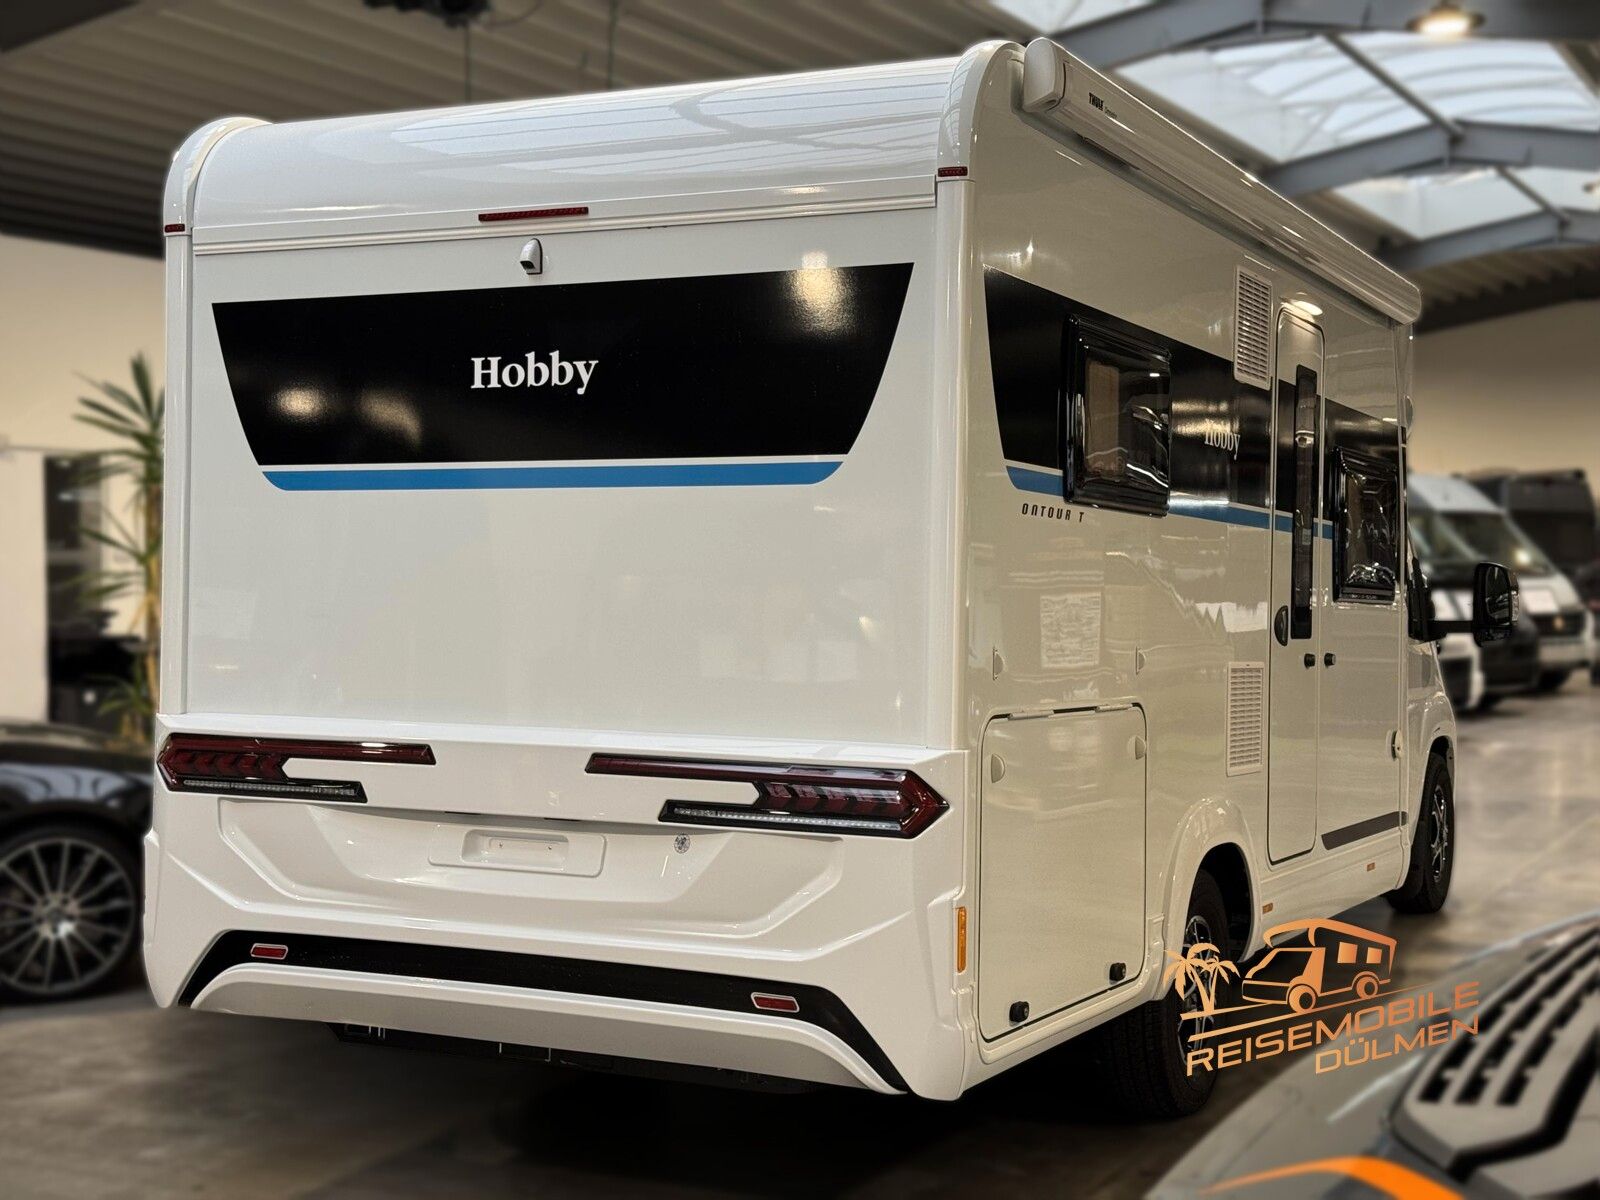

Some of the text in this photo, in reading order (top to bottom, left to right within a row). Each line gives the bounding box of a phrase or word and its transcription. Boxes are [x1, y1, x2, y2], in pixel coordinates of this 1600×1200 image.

[471, 350, 599, 395] Hobby
[1021, 503, 1085, 523] ONTOUR T
